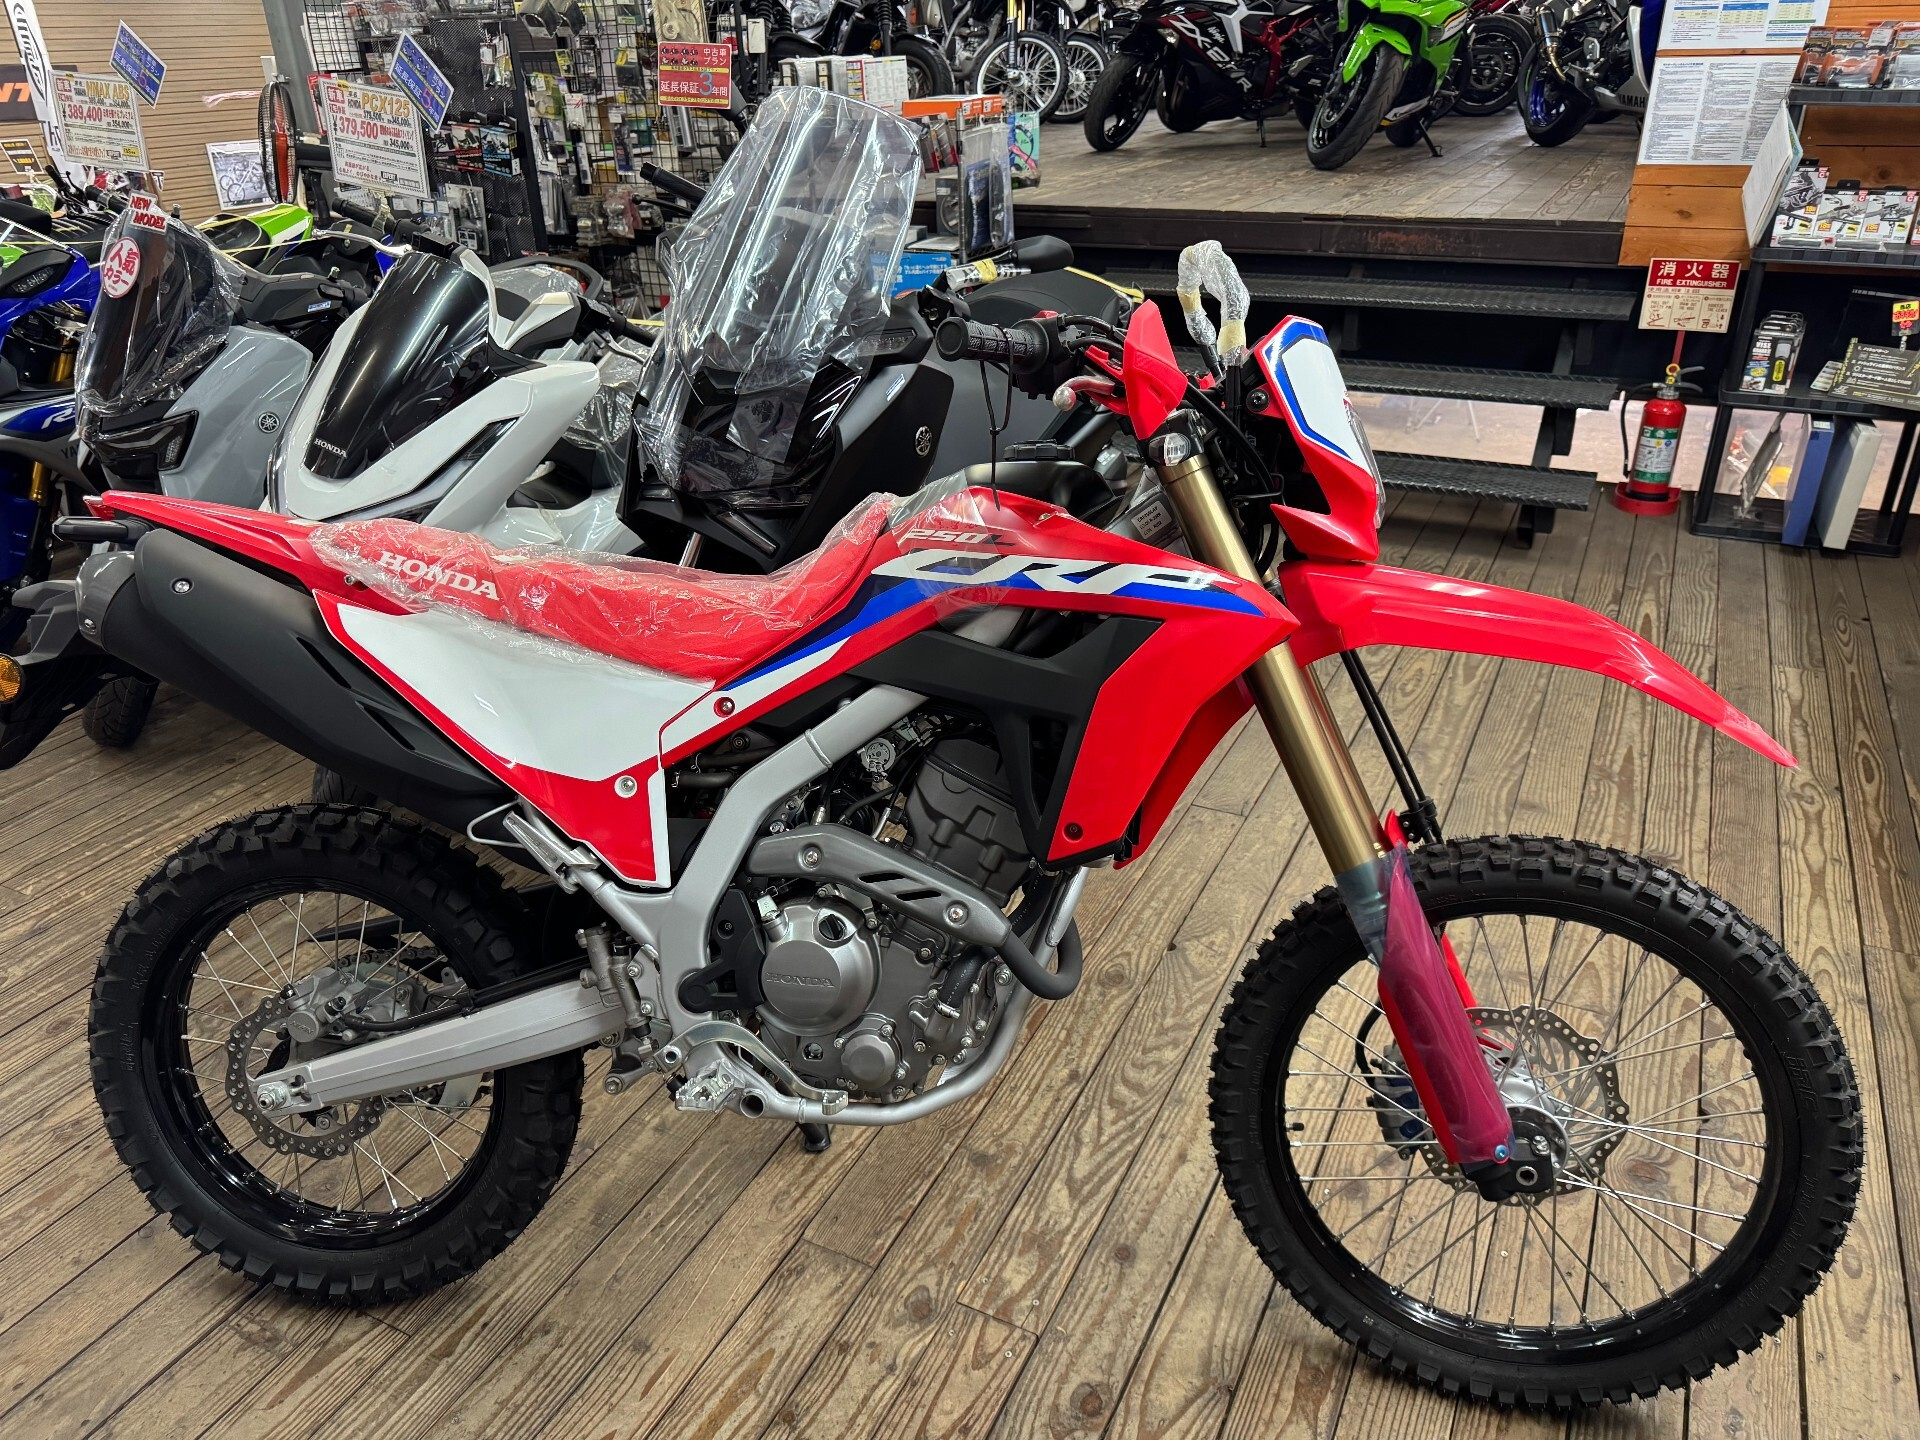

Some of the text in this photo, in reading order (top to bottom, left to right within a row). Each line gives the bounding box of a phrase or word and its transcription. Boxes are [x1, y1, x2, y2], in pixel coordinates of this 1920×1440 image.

[1206, 26, 1226, 44] Ninja
[703, 47, 727, 57] 中古車
[703, 56, 727, 66] プラン
[85, 80, 130, 100] NMAX ABS
[660, 71, 728, 97] 延長保証3年間
[326, 86, 345, 104] 新車
[1617, 93, 1648, 108] YAMAH
[361, 92, 411, 118] PCX125
[130, 196, 152, 211] NEW
[133, 212, 166, 230] MODEL
[110, 243, 140, 276] 人気
[104, 265, 129, 286] カラー
[1658, 262, 1730, 279] 消火器
[1676, 279, 1727, 288] EXTINGUISHER
[313, 438, 348, 459] HONDA
[380, 550, 500, 601] HONDA
[872, 548, 1243, 596] CRF
[766, 972, 835, 989] HONDA
